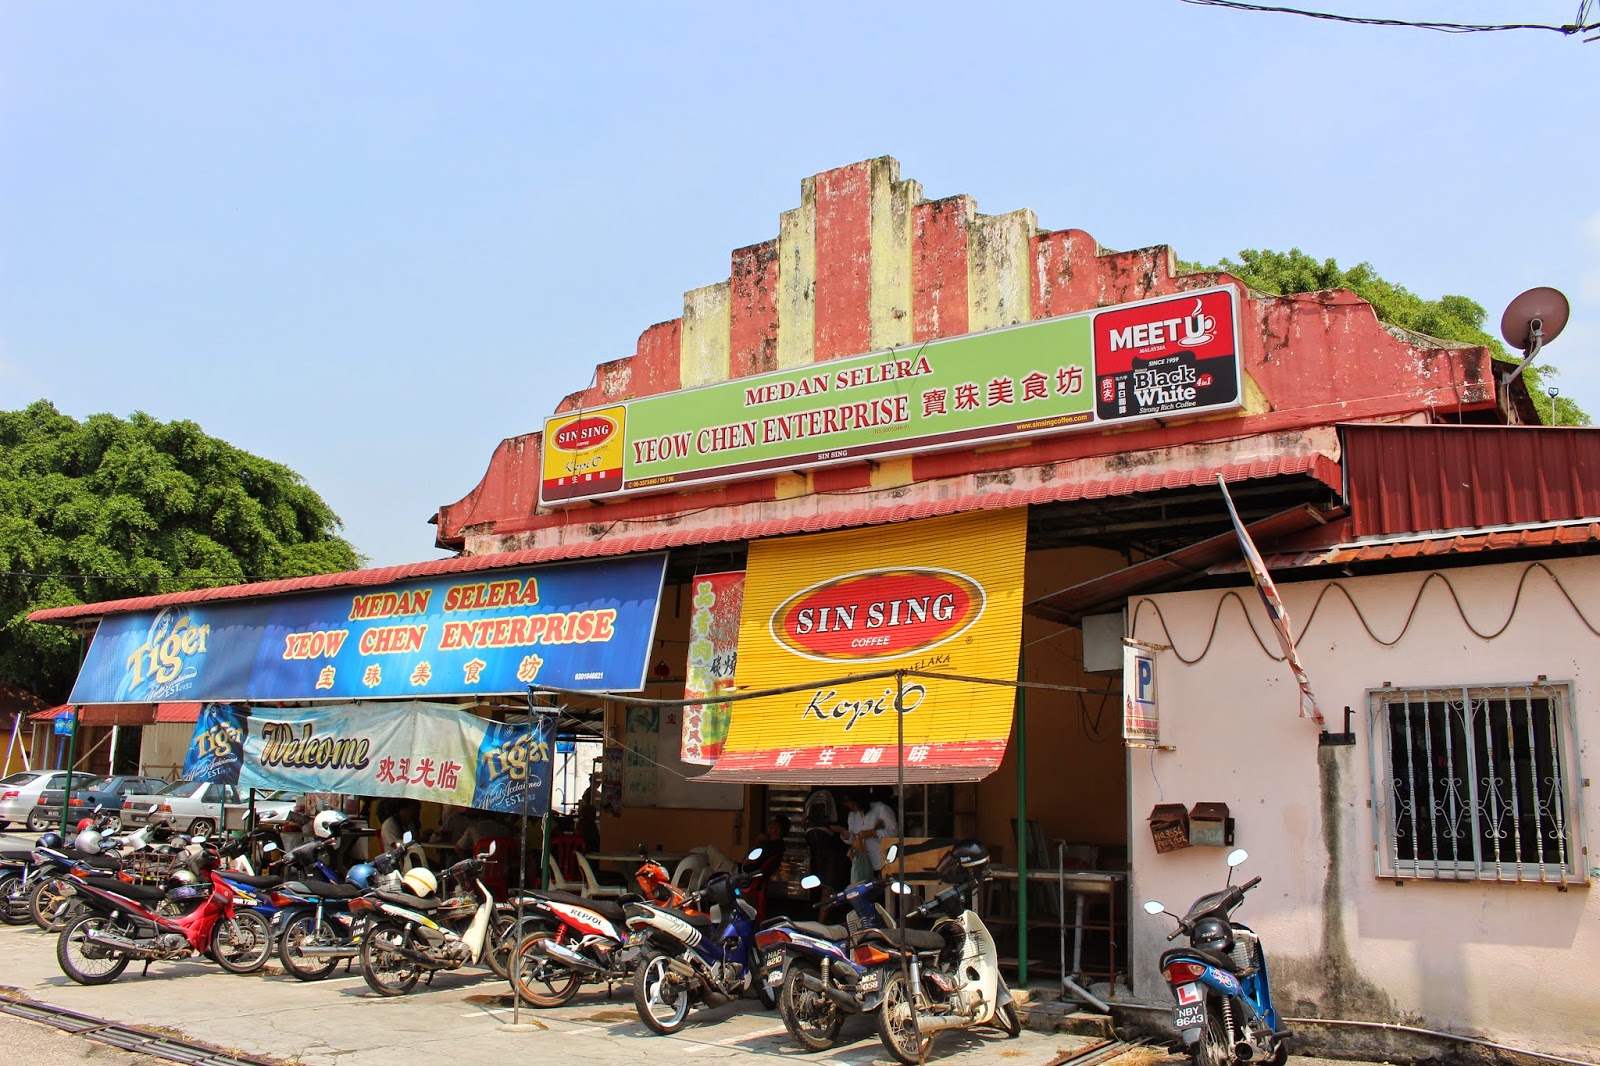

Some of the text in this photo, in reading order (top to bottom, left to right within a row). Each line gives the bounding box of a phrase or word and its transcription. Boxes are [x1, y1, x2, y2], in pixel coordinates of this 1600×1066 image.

[1109, 318, 1181, 353] MEET
[1139, 345, 1166, 353] MALAYSIA
[1148, 356, 1180, 367] SINCE 1959
[744, 355, 933, 406] MEDAN SELERA
[1134, 364, 1196, 390] Black
[921, 364, 1085, 418] 寶珠美食坊
[1134, 384, 1197, 407] White
[1139, 400, 1197, 414] Strong Rich Coffee
[559, 424, 609, 443] SIN SING
[632, 395, 910, 467] YEOW CHEN ENTERPRISE
[1016, 414, 1088, 431] www.sinsingcoffee.com
[831, 450, 848, 458] SING
[349, 577, 538, 621] MEDAN SELERA
[795, 593, 956, 635] SIN SING
[283, 608, 617, 660] YEOW CHEN ENTERPRISE
[851, 636, 890, 648] COFFEE
[127, 615, 210, 692] Tiger
[315, 653, 543, 690] 宝珠美食坊
[1138, 660, 1152, 699] P
[802, 681, 927, 732] Kopi O
[195, 722, 243, 758] Tiger
[260, 721, 371, 770] Welcome
[482, 734, 550, 781] Tiger
[774, 745, 928, 768] 新生咖啡
[570, 908, 602, 926] REPSOL
[768, 949, 782, 960] NAF
[1178, 987, 1196, 1004] L
[1176, 1014, 1204, 1027] 8643
[1179, 1006, 1199, 1018] NBY
